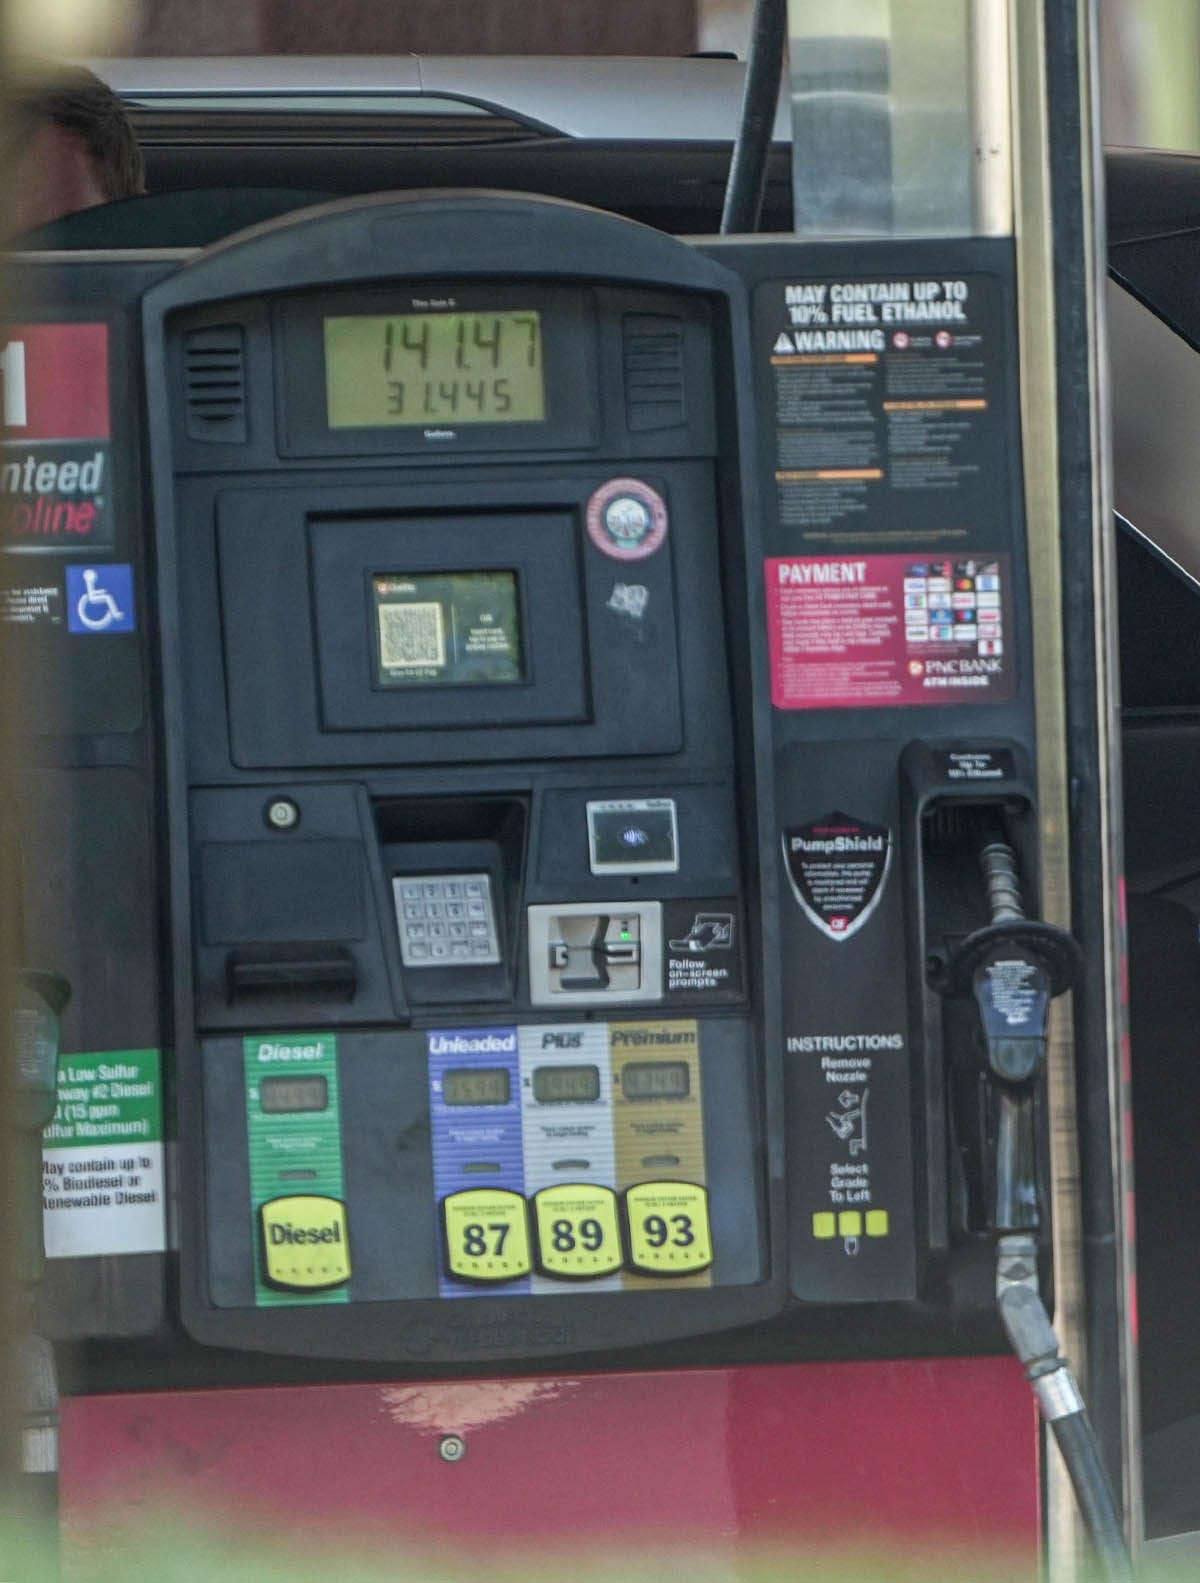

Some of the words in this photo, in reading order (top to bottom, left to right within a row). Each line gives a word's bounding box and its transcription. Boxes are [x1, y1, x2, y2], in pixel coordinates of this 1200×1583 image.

[785, 285, 826, 304] MAY
[830, 282, 911, 302] CONTAIN
[913, 281, 939, 301] UP
[942, 280, 968, 300] TO
[788, 305, 829, 324] 10%
[832, 303, 878, 322] FUEL
[882, 301, 967, 321] ETHANOL
[794, 329, 886, 351] WARNING
[778, 561, 867, 584] PAYMENT
[791, 836, 883, 855] PumpShield
[669, 958, 705, 969] Follow
[669, 968, 728, 978] on-screen
[669, 977, 717, 989] prompts
[428, 1032, 516, 1055] Unleaded
[542, 1030, 584, 1050] Plus
[611, 1028, 697, 1047] Premium
[787, 1034, 904, 1053] INSTRUCTIONS
[257, 1041, 325, 1062] Diesel
[821, 1056, 871, 1070] Remove
[825, 1070, 868, 1084] Nozzle
[110, 1080, 154, 1098] Diesel
[43, 1122, 74, 1139] ulfur
[75, 1118, 150, 1137] Maximum)
[68, 1156, 115, 1174] contain
[119, 1157, 135, 1172] up
[830, 1163, 868, 1176] Select
[63, 1174, 123, 1191] Biodiesel
[831, 1176, 868, 1189] Grade
[114, 1189, 156, 1205] Diesel
[829, 1189, 845, 1203] To
[846, 1188, 872, 1203] Left
[269, 1220, 341, 1246] Diesel
[463, 1222, 510, 1257] 87
[551, 1218, 604, 1253] 89
[643, 1213, 695, 1248] 93
